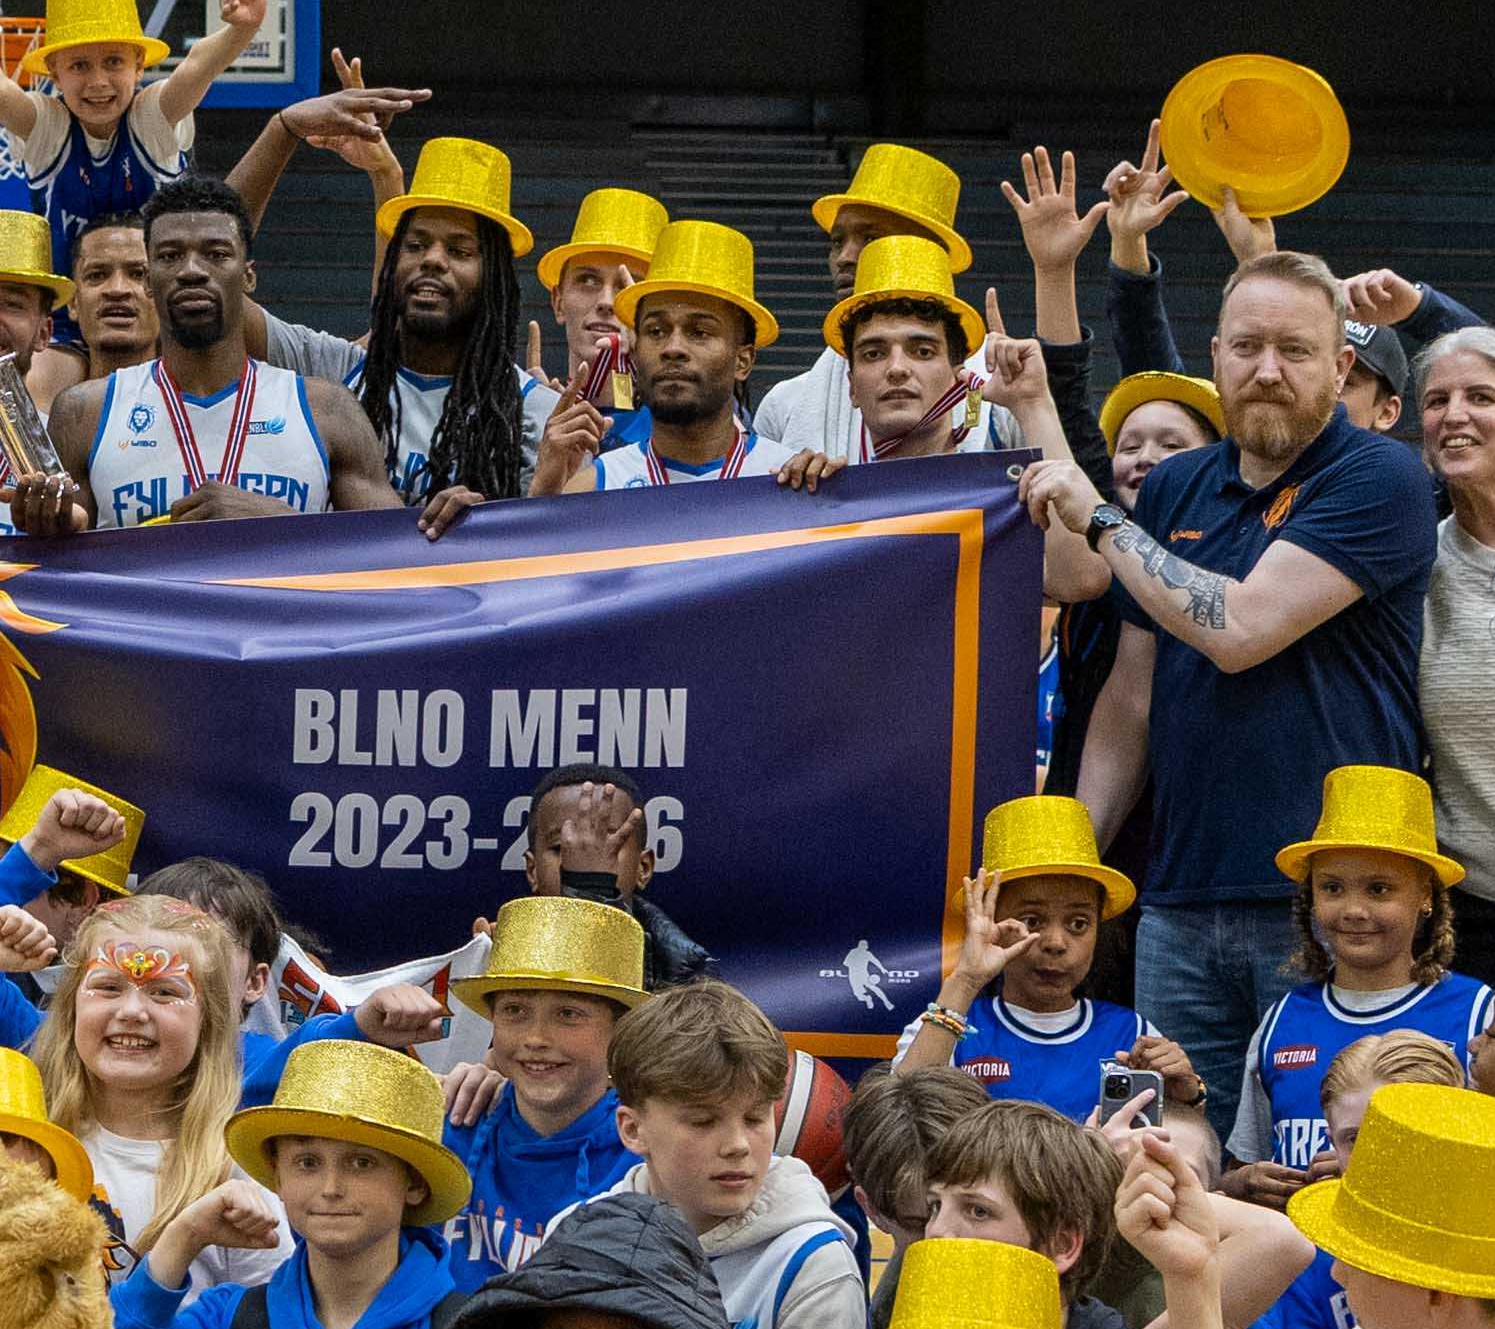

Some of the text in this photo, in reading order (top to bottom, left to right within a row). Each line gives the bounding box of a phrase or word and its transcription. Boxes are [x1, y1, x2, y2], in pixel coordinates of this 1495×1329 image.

[293, 688, 687, 768] BLNO MENN
[1273, 1047, 1317, 1065] VICTORIA
